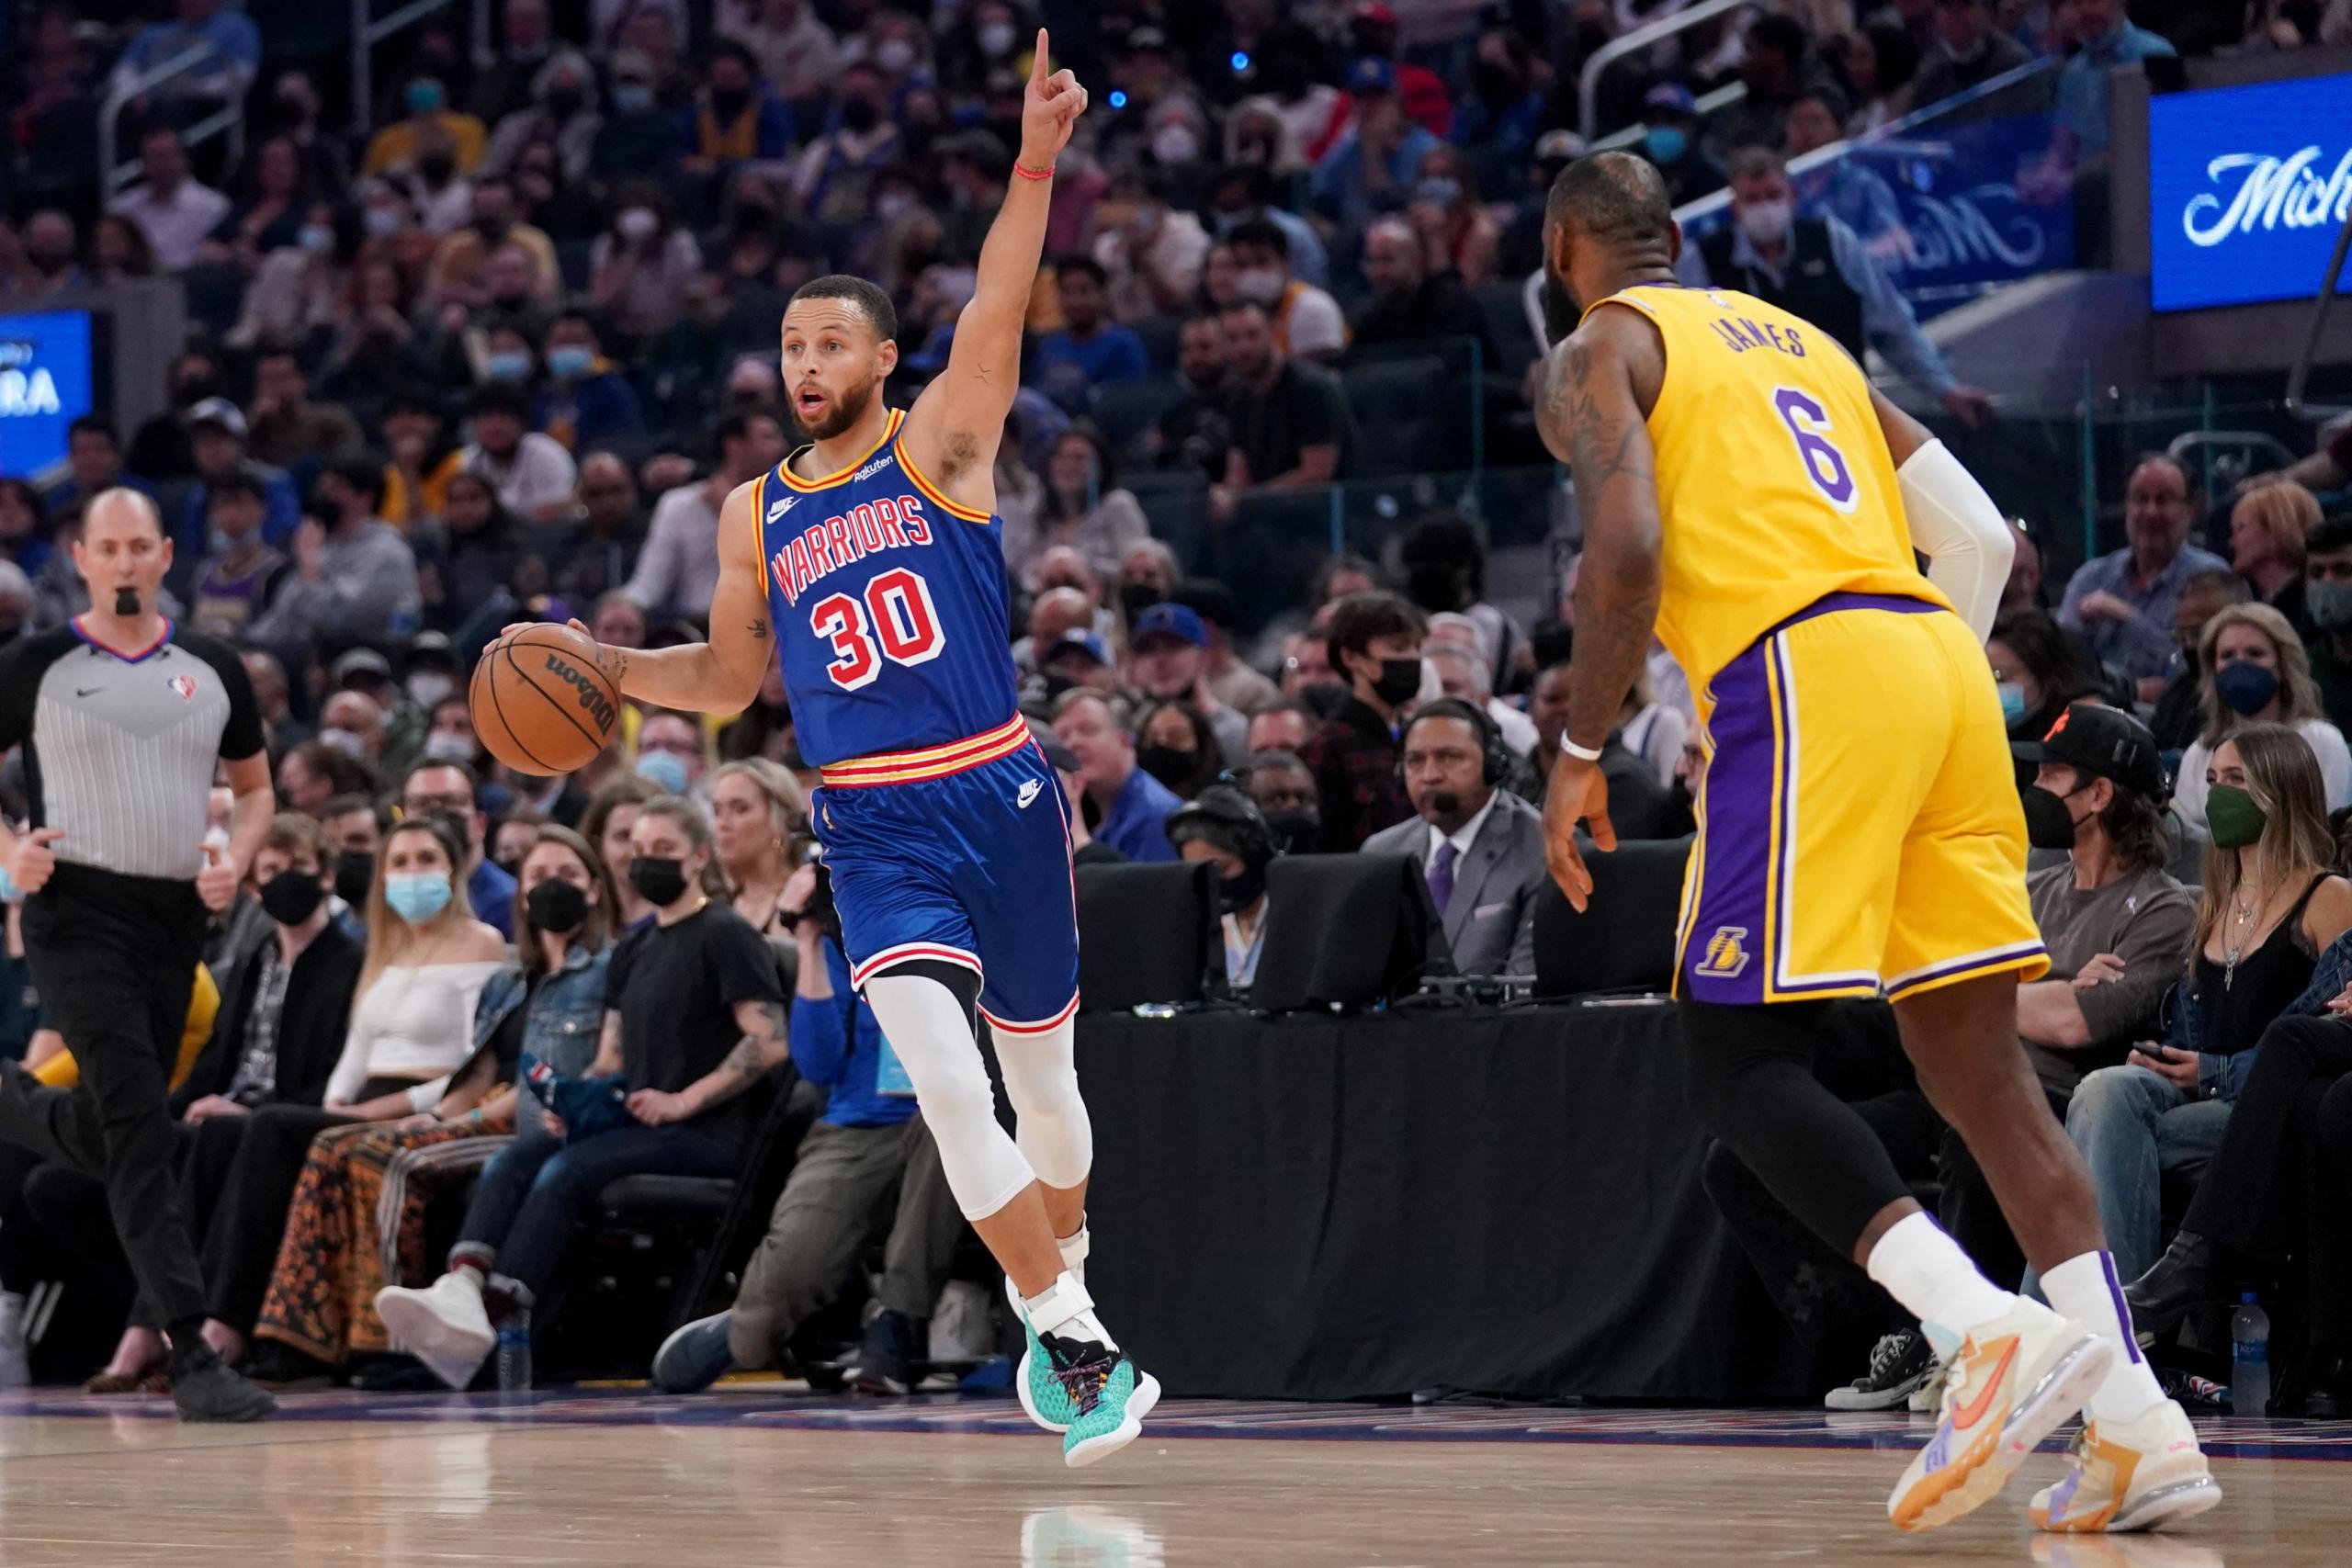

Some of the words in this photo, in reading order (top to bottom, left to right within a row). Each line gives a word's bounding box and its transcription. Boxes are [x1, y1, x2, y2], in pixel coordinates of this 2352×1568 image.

[1709, 317, 1805, 357] JAMES
[854, 455, 893, 483] Rakuten
[1773, 386, 1860, 513] 6
[771, 495, 933, 608] WARRIORS
[809, 567, 945, 692] 30
[545, 653, 616, 737] Wilson
